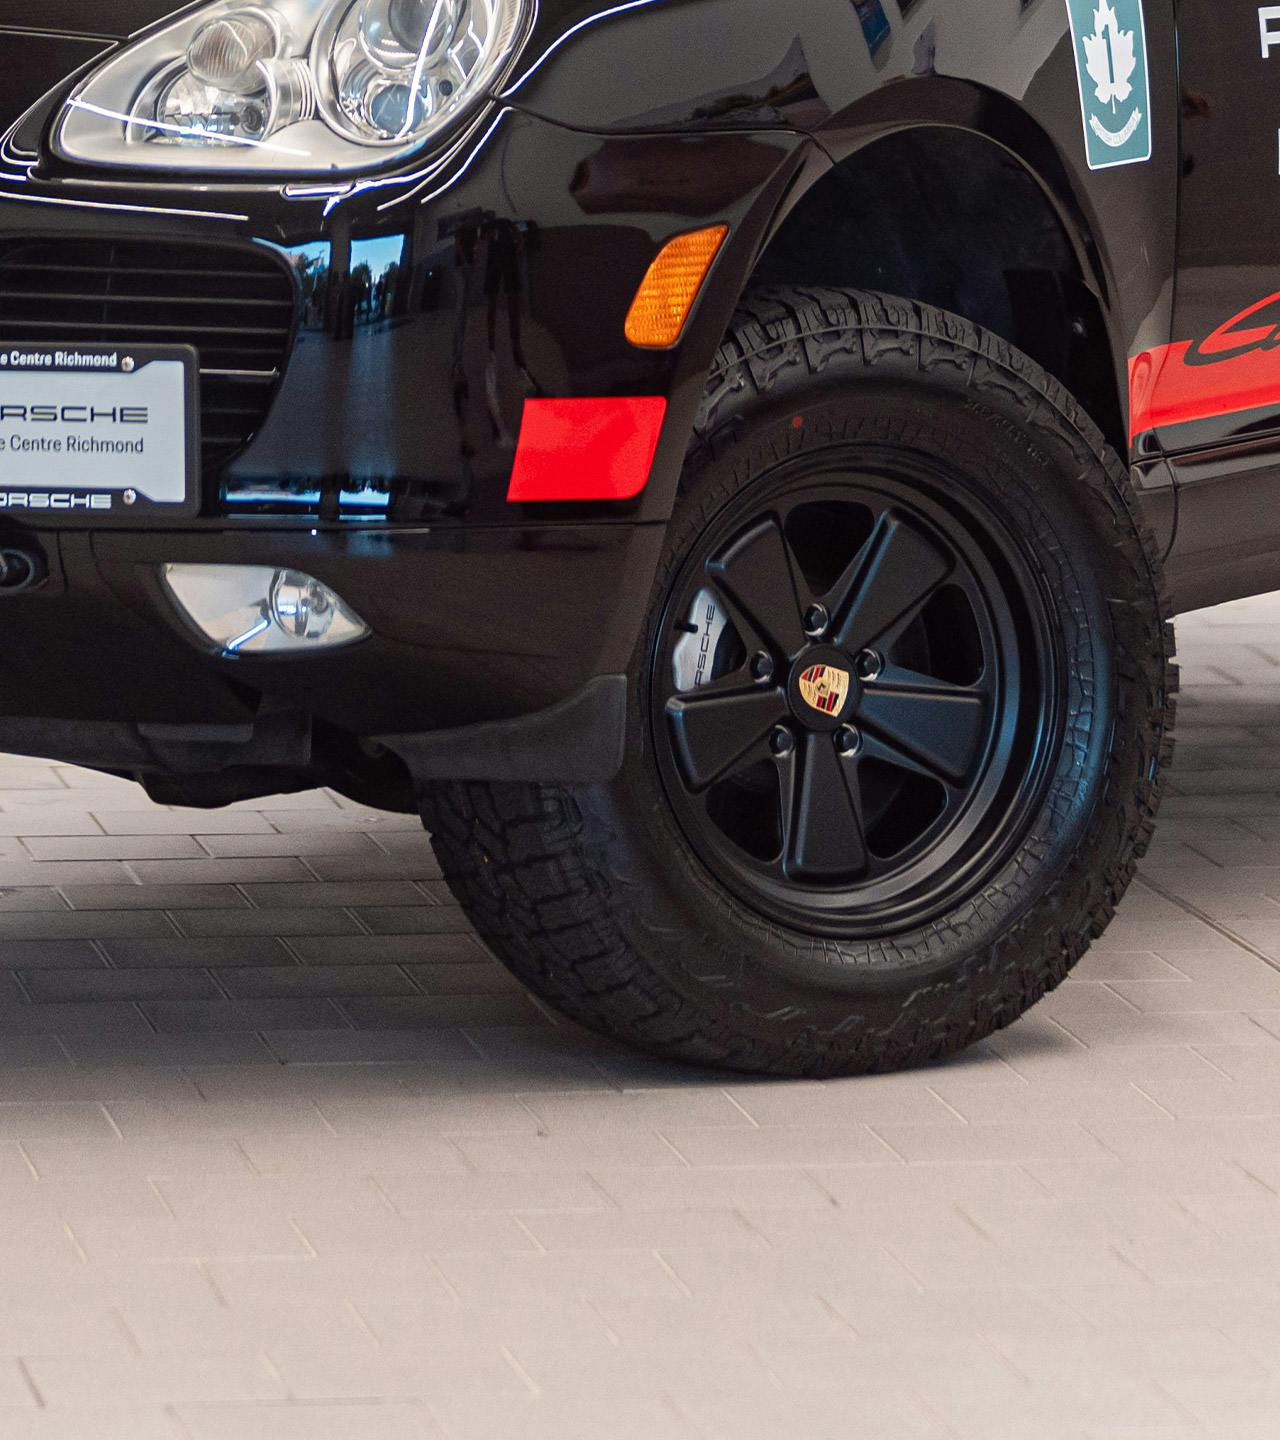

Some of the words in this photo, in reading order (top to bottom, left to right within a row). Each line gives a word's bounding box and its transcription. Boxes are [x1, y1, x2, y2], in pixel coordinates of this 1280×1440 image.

[1101, 23, 1115, 84] 1
[10, 350, 52, 367] Centre
[54, 350, 118, 368] Richmond
[10, 434, 62, 452] Centre
[66, 436, 144, 454] Richmond
[694, 604, 716, 687] RSCHE
